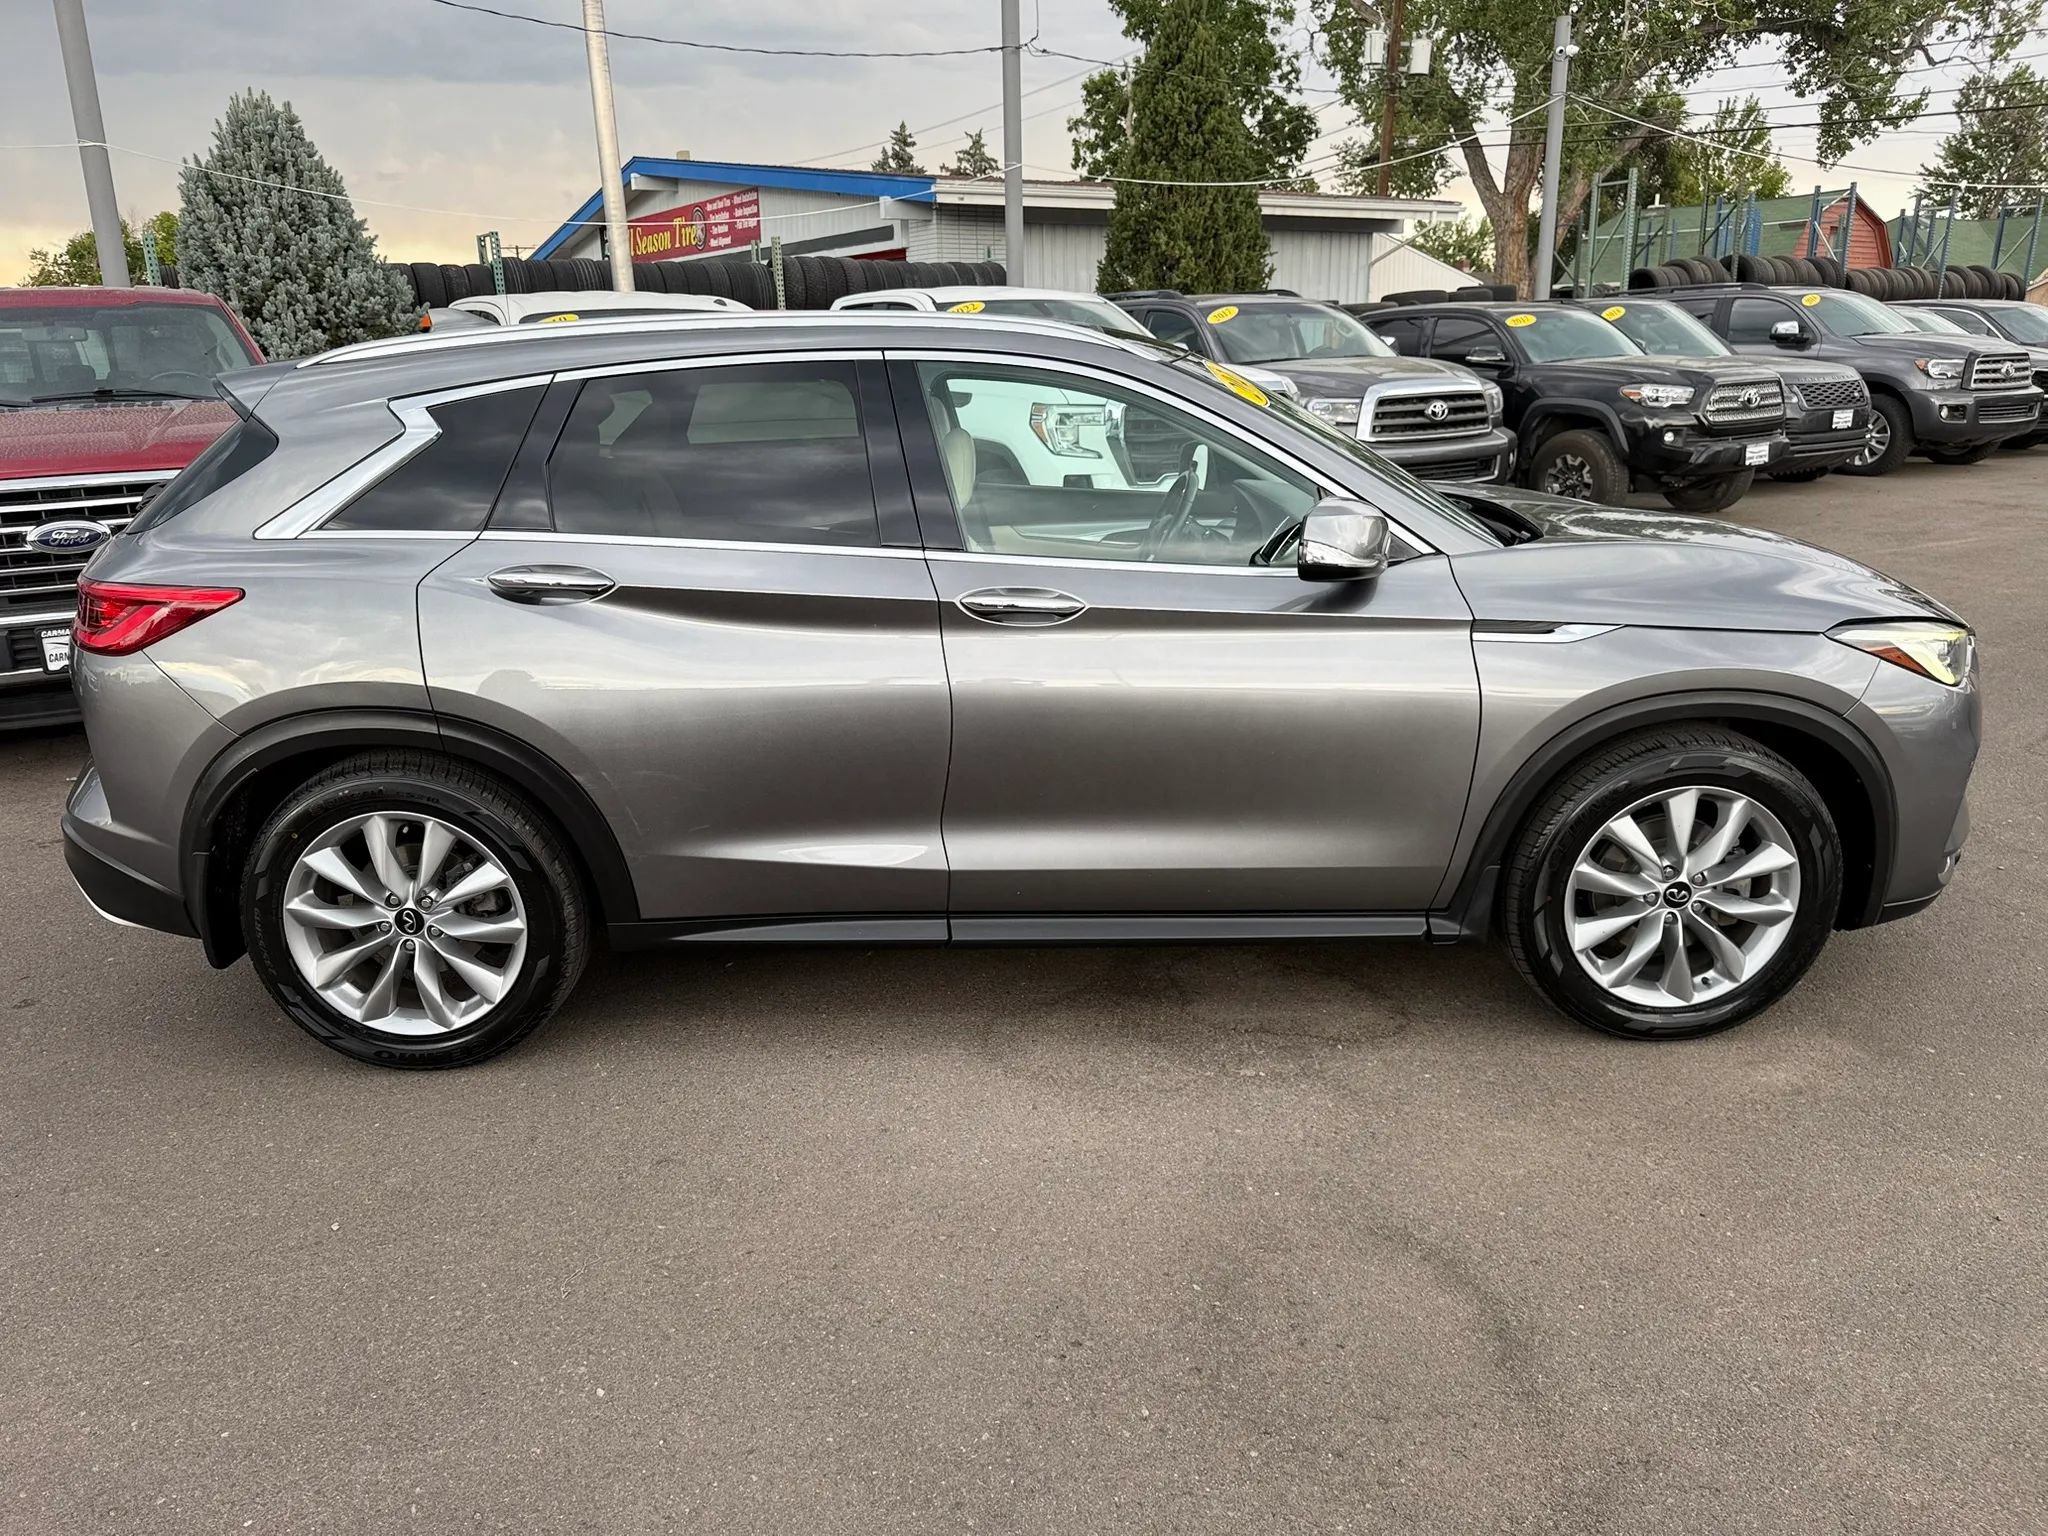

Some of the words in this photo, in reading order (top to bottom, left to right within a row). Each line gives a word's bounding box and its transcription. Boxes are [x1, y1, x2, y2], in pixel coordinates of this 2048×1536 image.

[636, 226, 671, 255] Season
[673, 216, 698, 248] Tire
[49, 529, 90, 546] Ford
